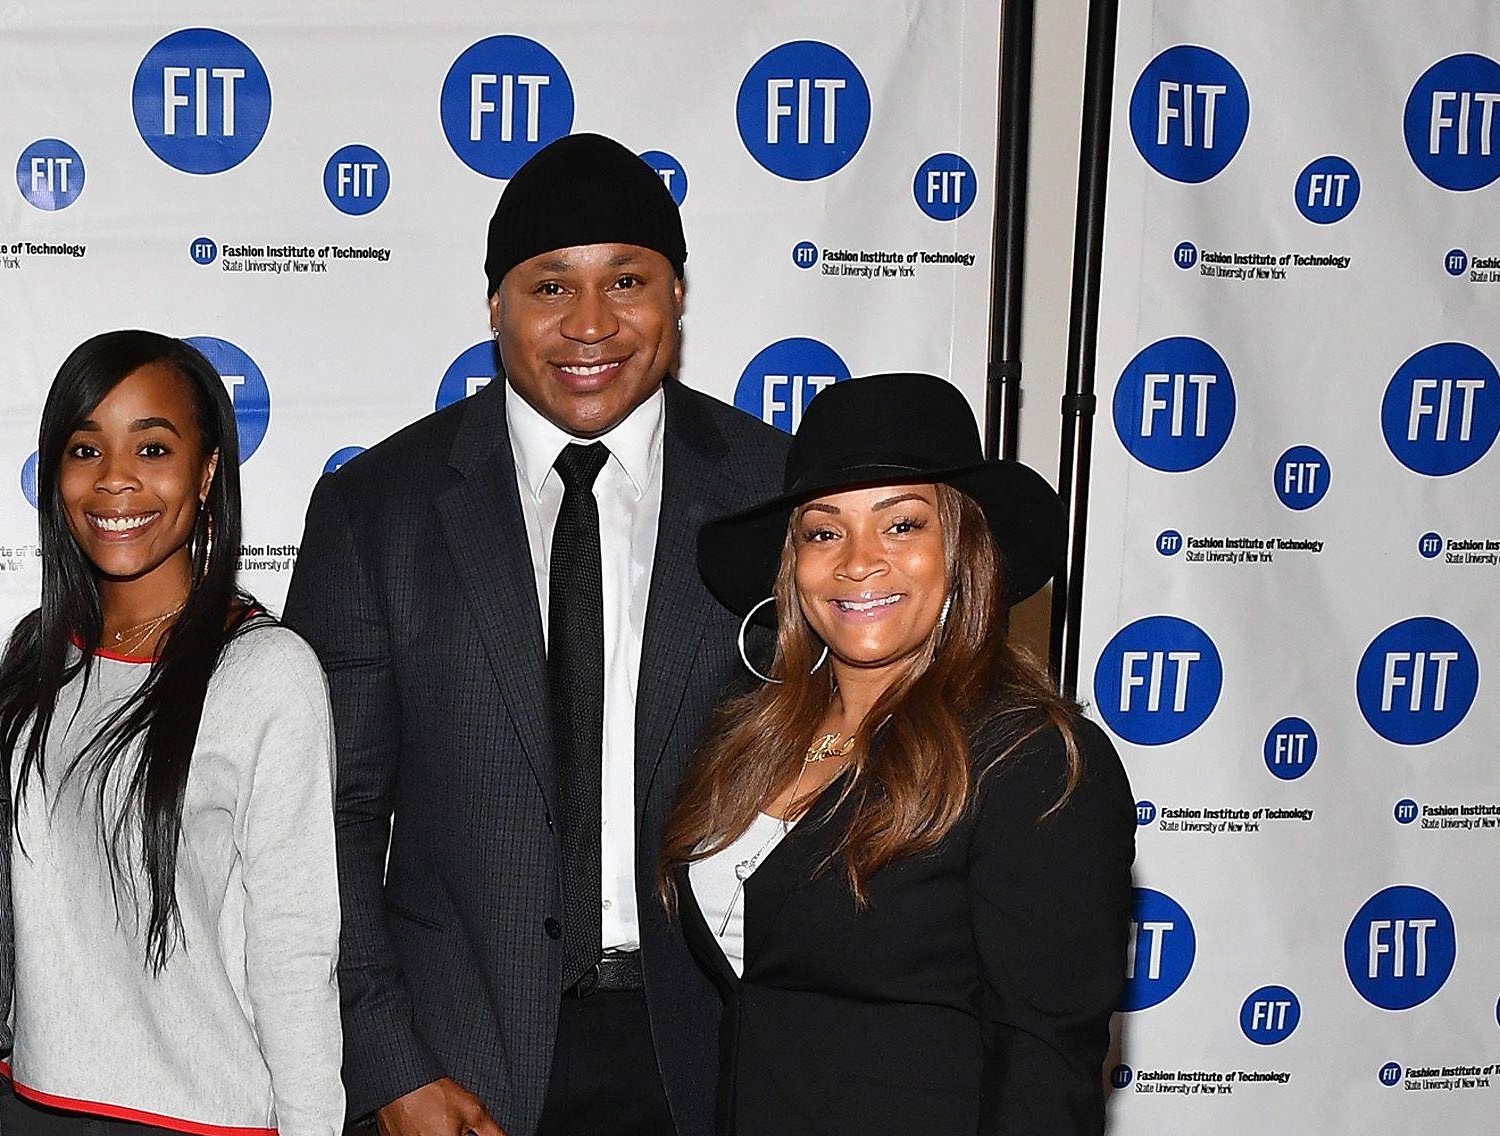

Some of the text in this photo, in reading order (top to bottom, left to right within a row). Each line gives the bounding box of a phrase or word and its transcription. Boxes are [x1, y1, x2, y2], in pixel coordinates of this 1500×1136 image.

[164, 67, 245, 137] FIT
[471, 74, 549, 142] FIT
[767, 79, 846, 144] FIT
[1157, 81, 1227, 149] FIT
[1429, 92, 1500, 156] FIT
[30, 157, 73, 193] FIT
[337, 163, 378, 197] FIT
[927, 171, 966, 203] FIT
[1307, 175, 1350, 207] FIT
[11, 242, 23, 254] of
[25, 243, 86, 257] Technology
[196, 244, 214, 259] FIT
[222, 245, 391, 261] Fashion Institute of Technology
[798, 249, 815, 262] FIT
[822, 249, 975, 266] Fashion Institute of Technology
[1179, 249, 1195, 263] FIT
[2, 257, 20, 269] York
[222, 260, 327, 274] State University of New York
[1200, 250, 1351, 268] Fashion Institute of Technology
[1450, 256, 1465, 270] FIT
[821, 263, 915, 278] State University of New York
[1141, 374, 1217, 437] FIT
[1408, 380, 1486, 441] FIT
[1284, 463, 1320, 494] FIT
[1161, 537, 1179, 550] FIT
[1187, 537, 1324, 552] Fashion Institute of Technology
[1424, 539, 1440, 552] FIT
[1446, 540, 1484, 550] Fashion
[1120, 652, 1200, 712] FIT
[1382, 652, 1458, 712] FIT
[1275, 734, 1309, 764] FIT
[1161, 808, 1313, 820] Fashion Institute of Technology
[1399, 805, 1415, 818] FIT
[1423, 805, 1459, 816] Fashion
[1160, 821, 1260, 833] State University of New York
[1126, 922, 1174, 980] IT
[1369, 920, 1437, 978] FIT
[1252, 1001, 1290, 1030] FIT
[1137, 1071, 1175, 1082] Fashion
[1178, 1072, 1223, 1082] Institute
[1225, 1072, 1236, 1082] of
[1237, 1072, 1291, 1083] Technology
[1383, 1068, 1398, 1081] FIT
[1405, 1067, 1440, 1077] Fashion
